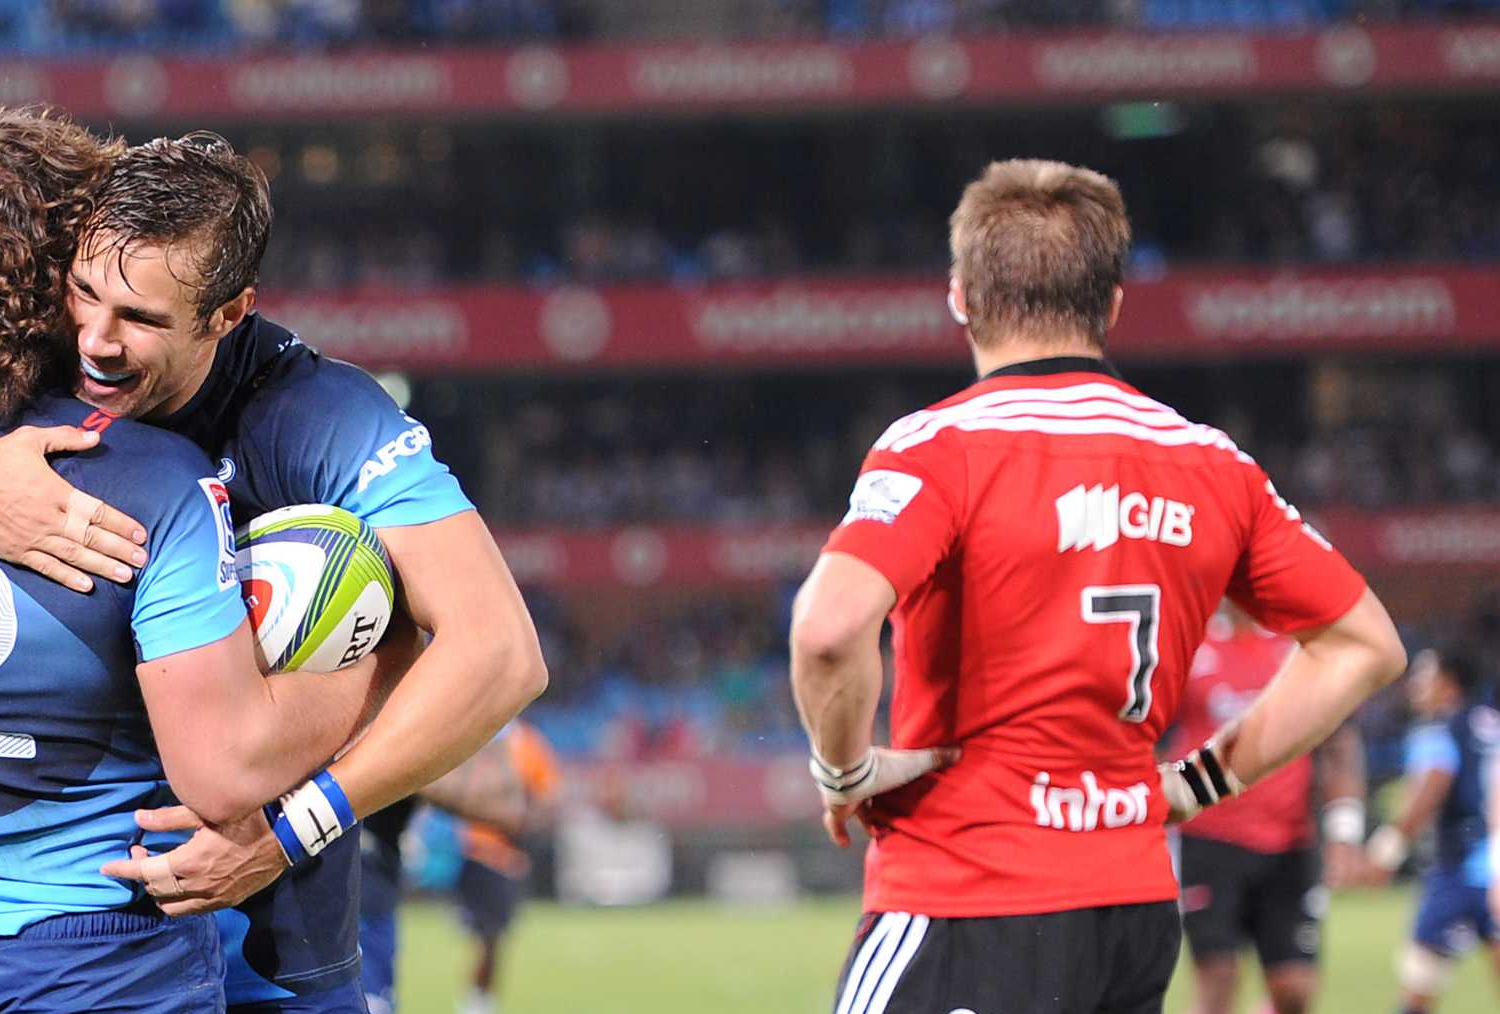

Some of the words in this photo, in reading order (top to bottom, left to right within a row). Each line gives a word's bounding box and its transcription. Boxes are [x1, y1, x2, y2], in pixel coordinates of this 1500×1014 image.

[357, 424, 432, 493] AFGR
[1119, 492, 1193, 547] GIB
[1080, 583, 1162, 724] 7
